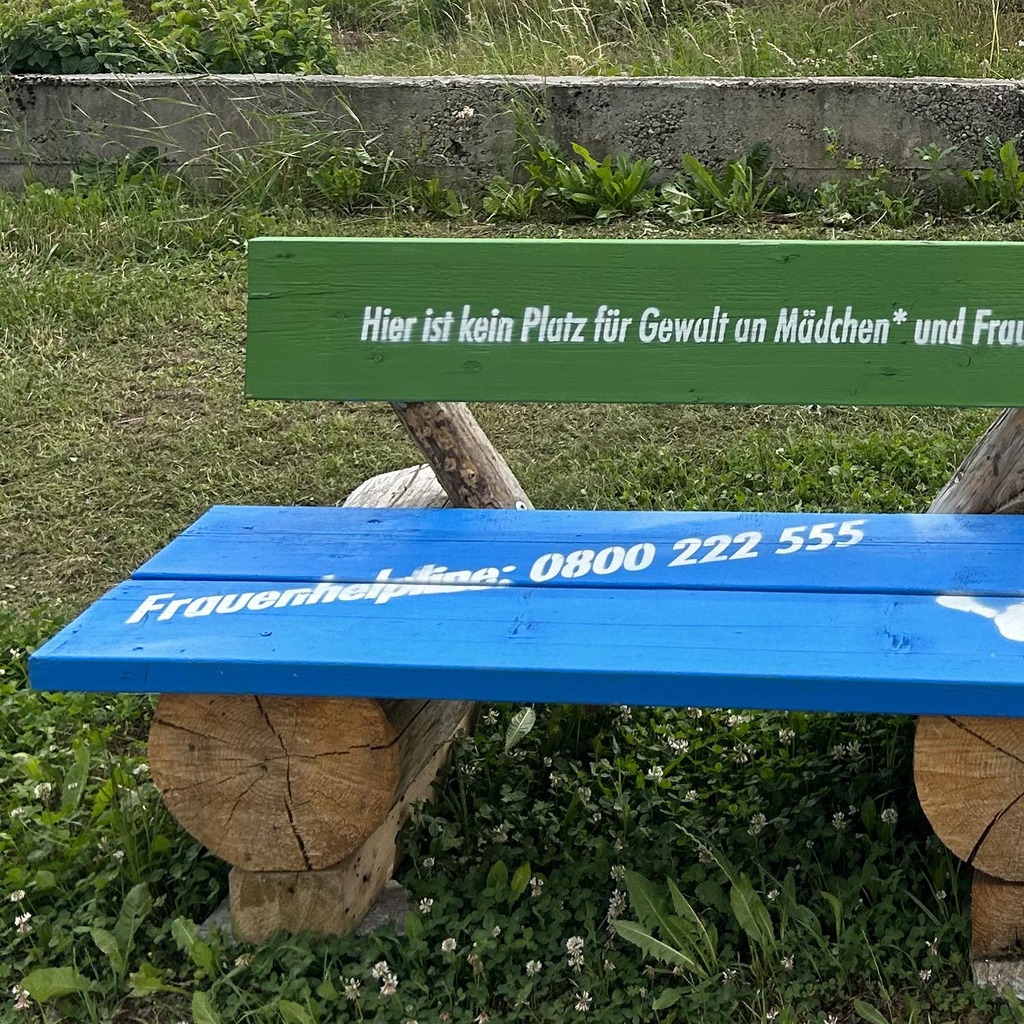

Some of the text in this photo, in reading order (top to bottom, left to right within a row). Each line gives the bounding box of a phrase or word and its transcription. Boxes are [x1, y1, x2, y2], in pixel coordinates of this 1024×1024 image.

[359, 305, 418, 343] Hier
[421, 307, 454, 343] ist
[458, 304, 514, 343] kein
[520, 305, 588, 343] Platz
[593, 304, 632, 343] für
[638, 305, 730, 343] Gewalt
[734, 318, 767, 343] an
[914, 306, 967, 346] und
[125, 519, 868, 625] Frauenhelpline: 0800 222 555
